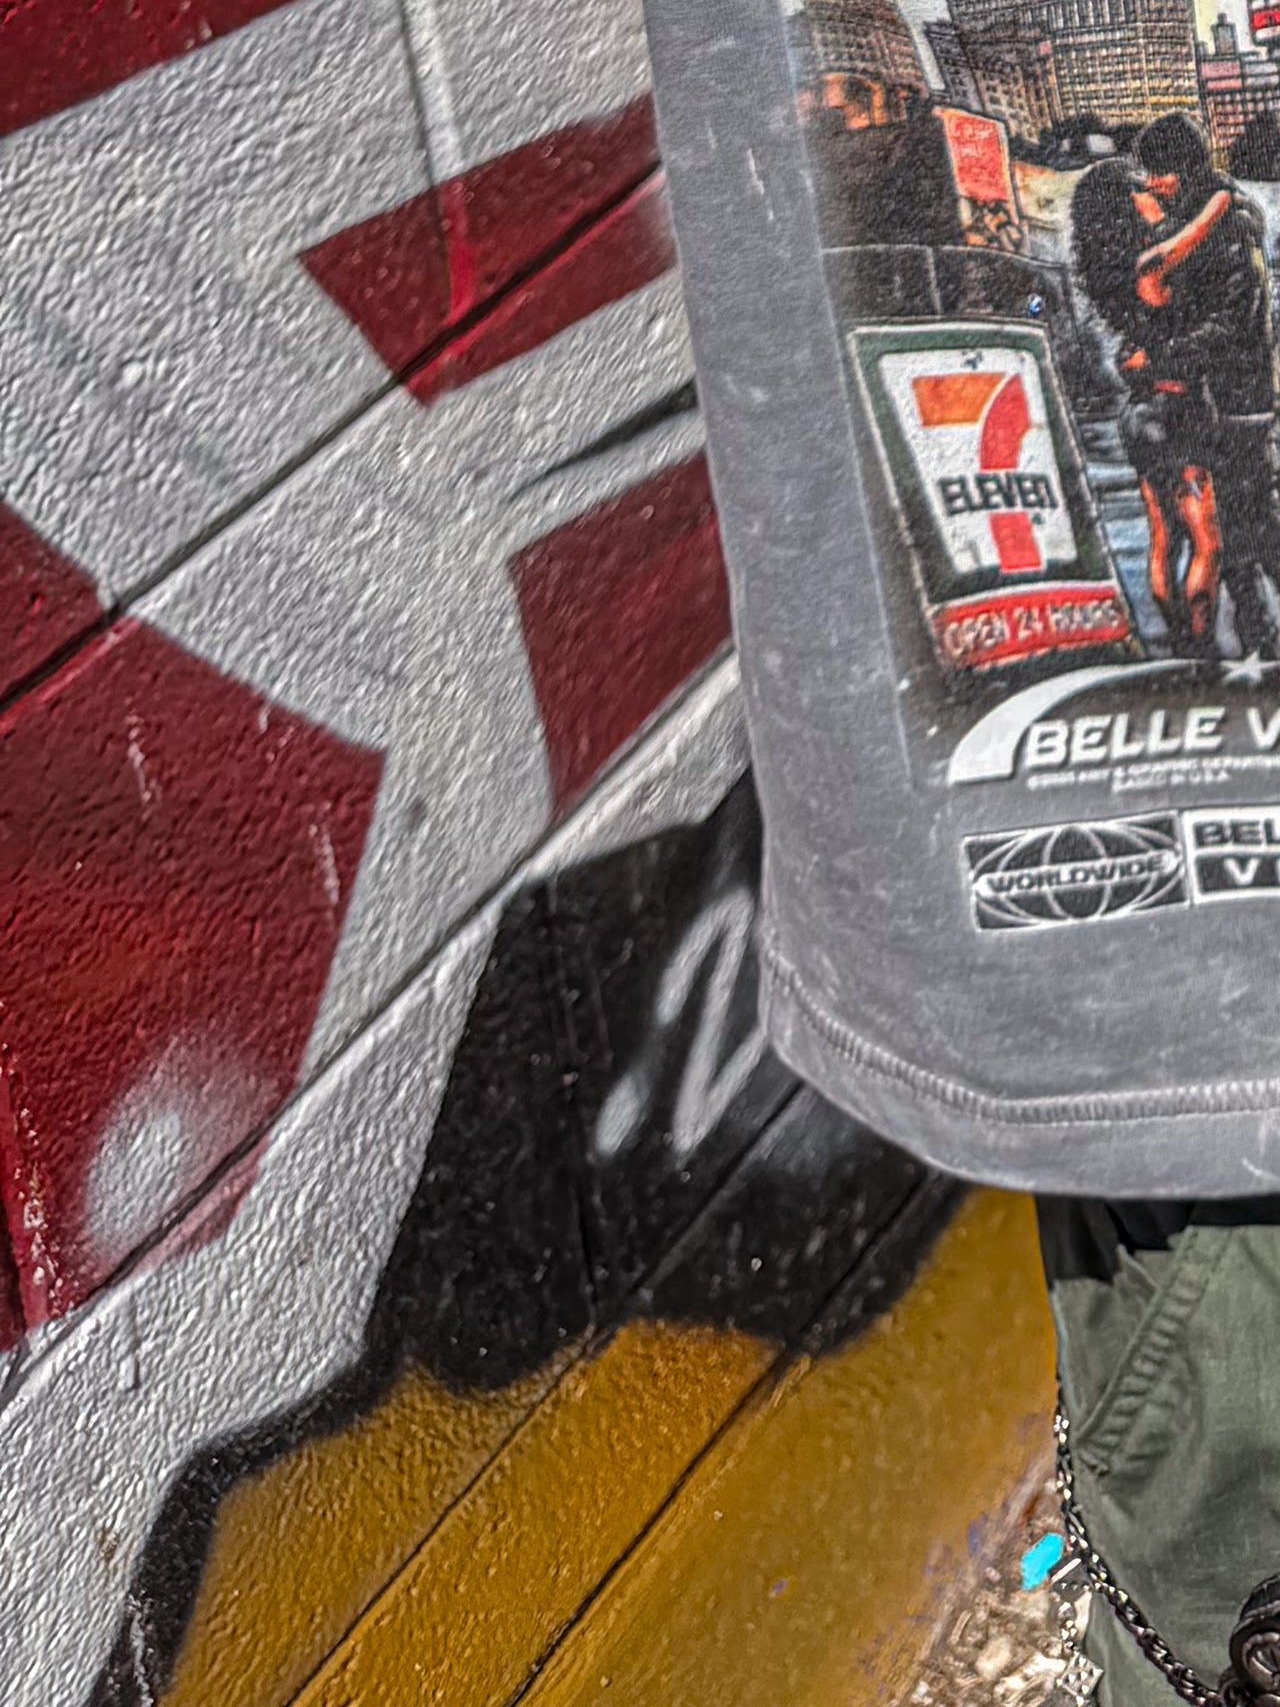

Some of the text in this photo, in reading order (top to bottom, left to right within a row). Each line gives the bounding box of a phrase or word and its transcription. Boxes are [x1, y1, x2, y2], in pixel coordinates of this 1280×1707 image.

[911, 372, 1043, 572] 7
[944, 609, 1010, 656] OPEN
[1013, 605, 1045, 641] 24
[1024, 706, 1226, 770] BELLE
[987, 852, 1167, 895] WORLDWIDE
